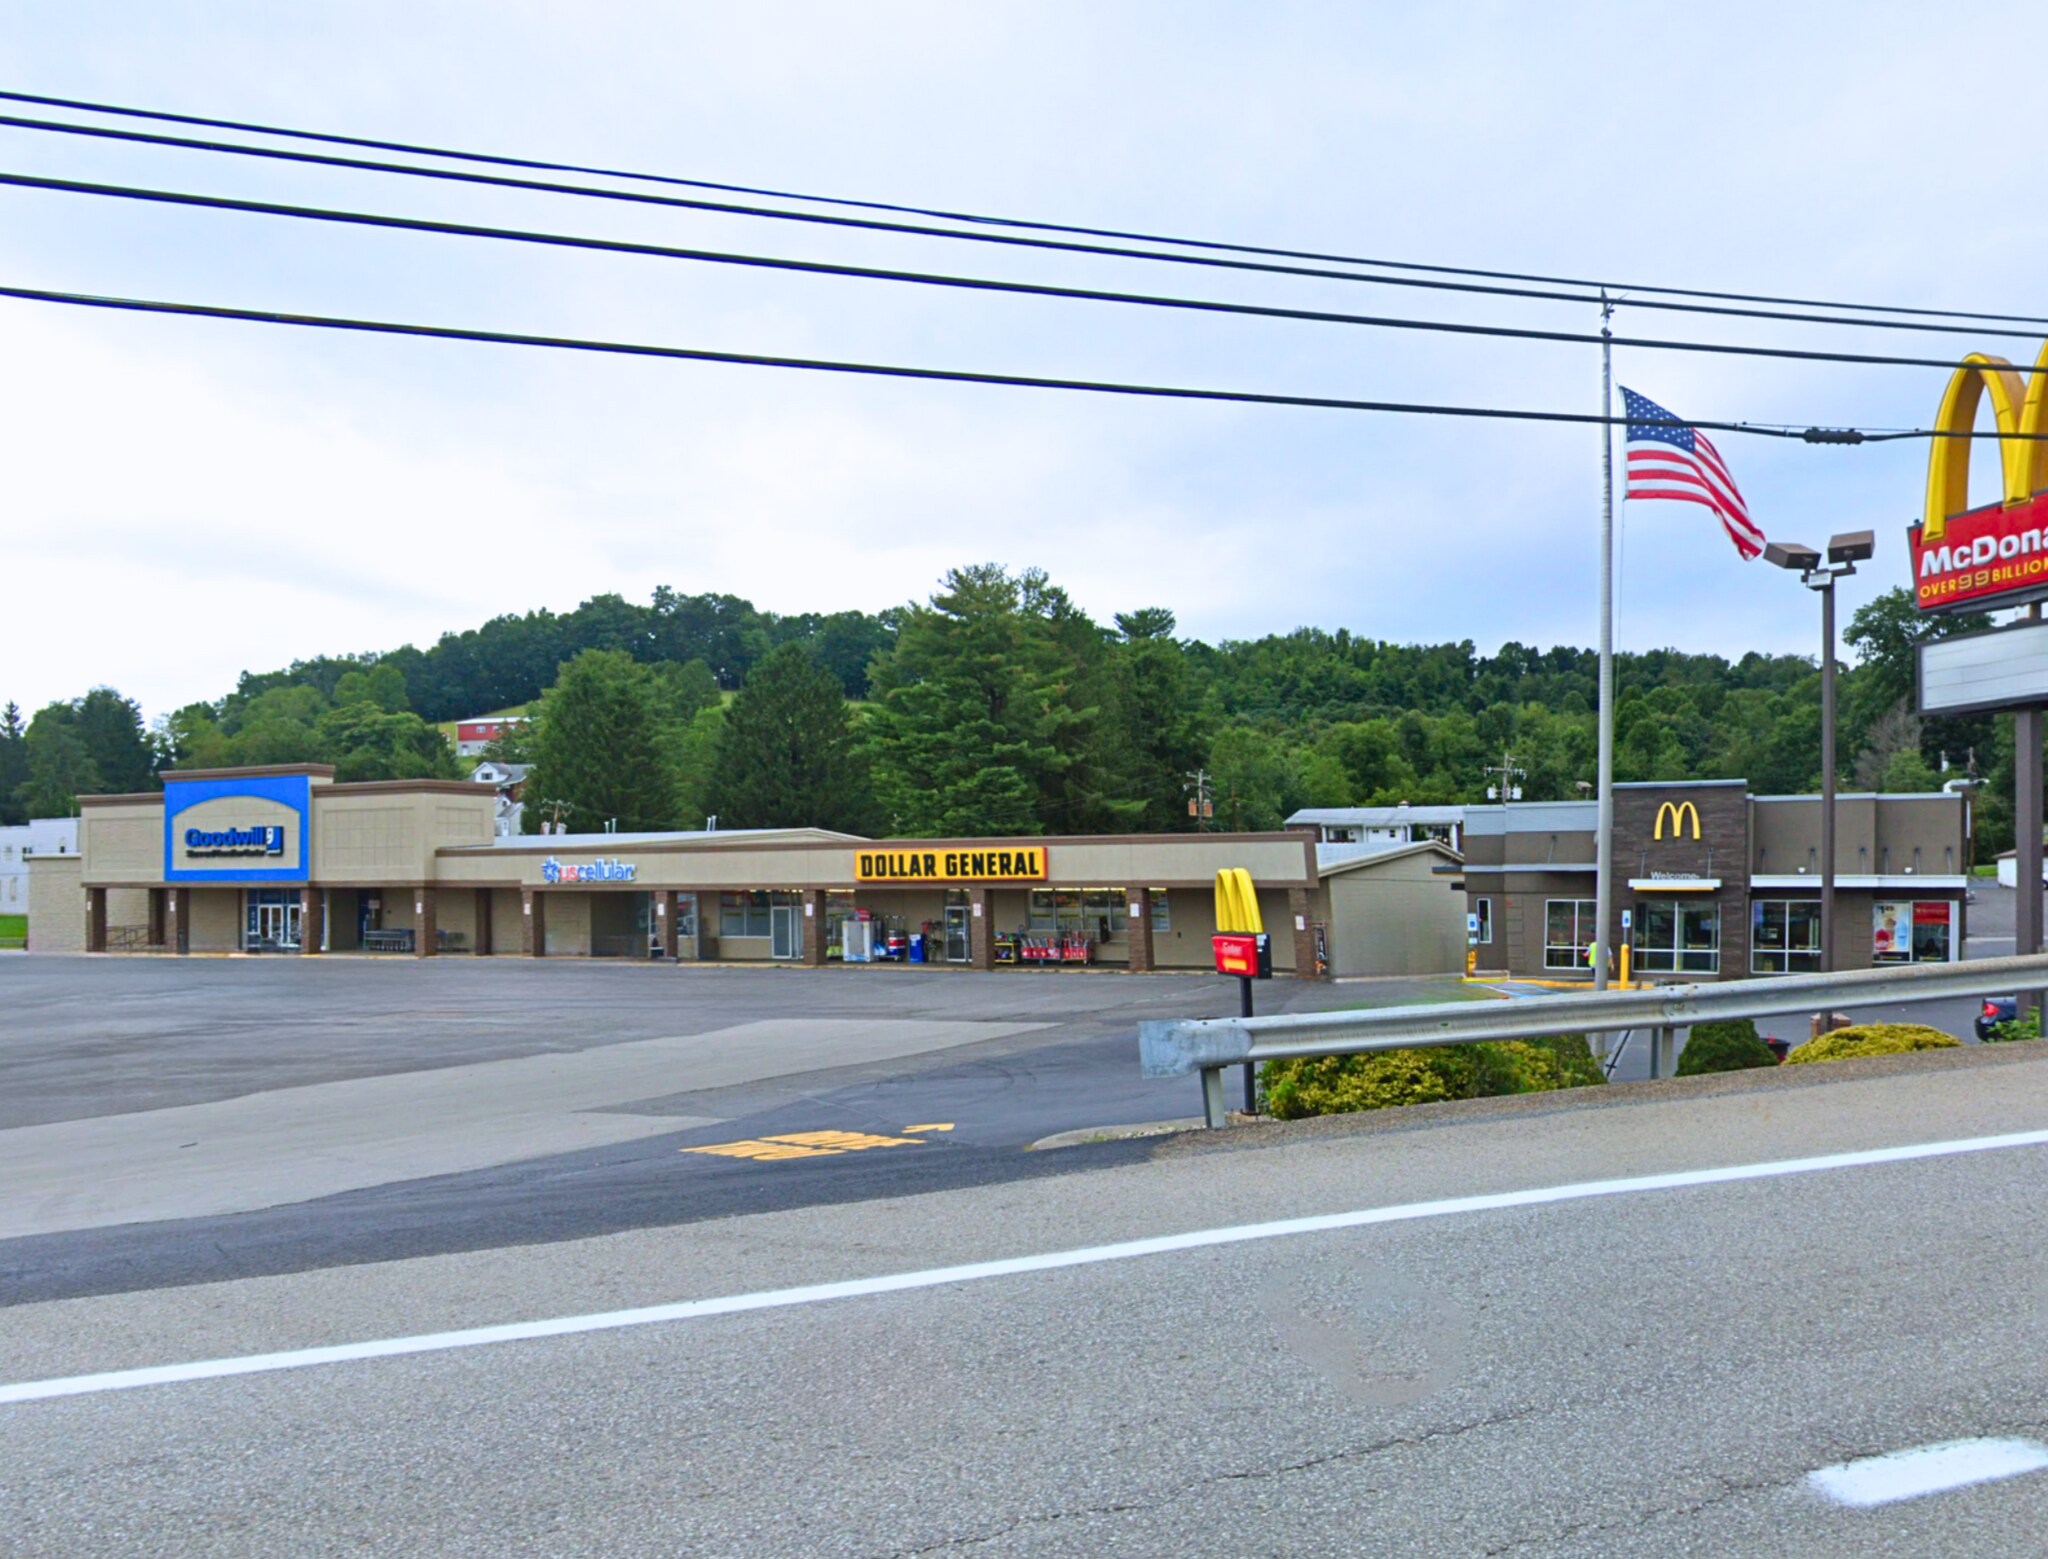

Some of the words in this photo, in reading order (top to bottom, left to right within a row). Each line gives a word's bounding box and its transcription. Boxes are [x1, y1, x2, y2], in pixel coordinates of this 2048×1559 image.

[1920, 579, 1957, 598] OVER
[1958, 570, 1990, 590] 99
[185, 826, 264, 847] Goodwill
[860, 854, 937, 877] DOLLAR
[945, 852, 1040, 876] GENERAL
